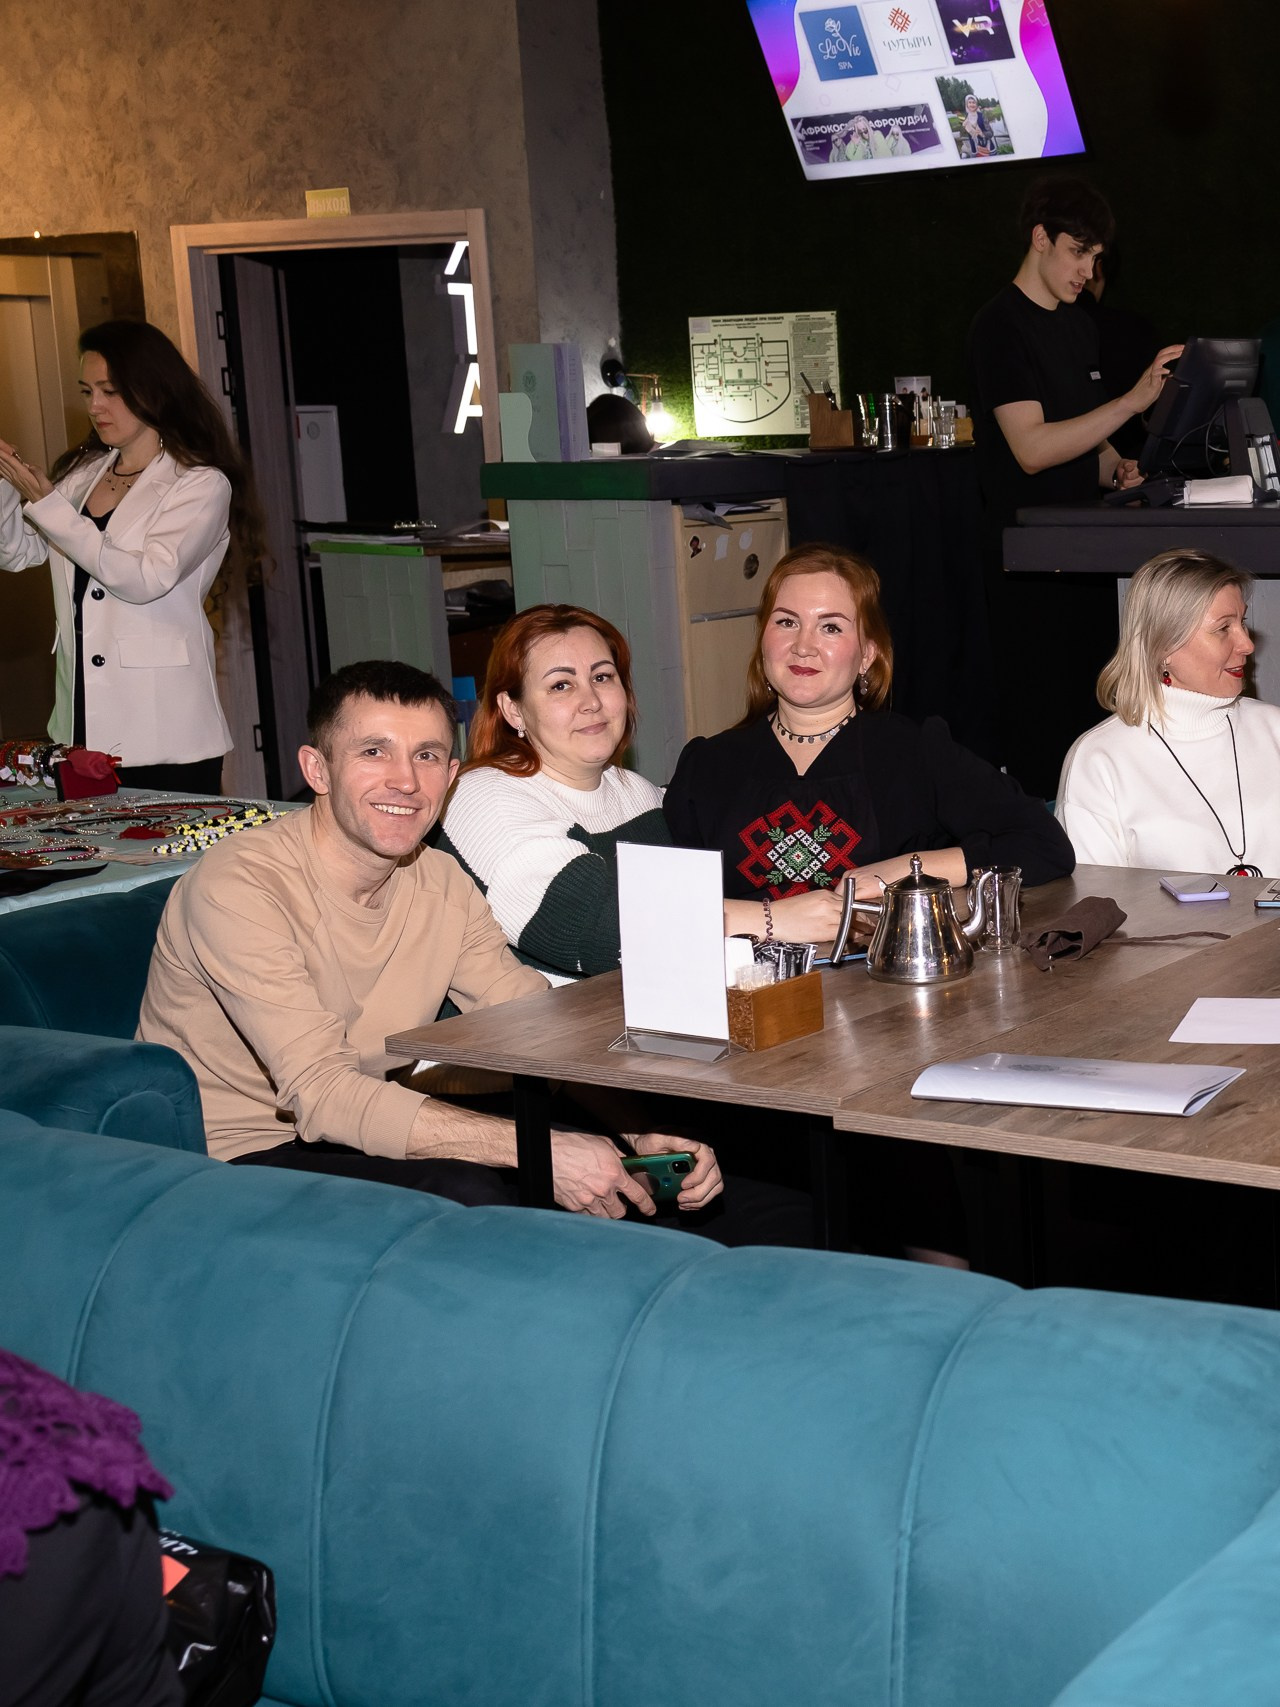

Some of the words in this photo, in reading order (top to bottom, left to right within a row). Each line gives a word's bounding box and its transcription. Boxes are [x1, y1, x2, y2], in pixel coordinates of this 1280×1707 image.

[818, 38, 838, 59] La
[838, 61, 853, 70] SPA
[869, 114, 928, 129] АФРОКУДРИ
